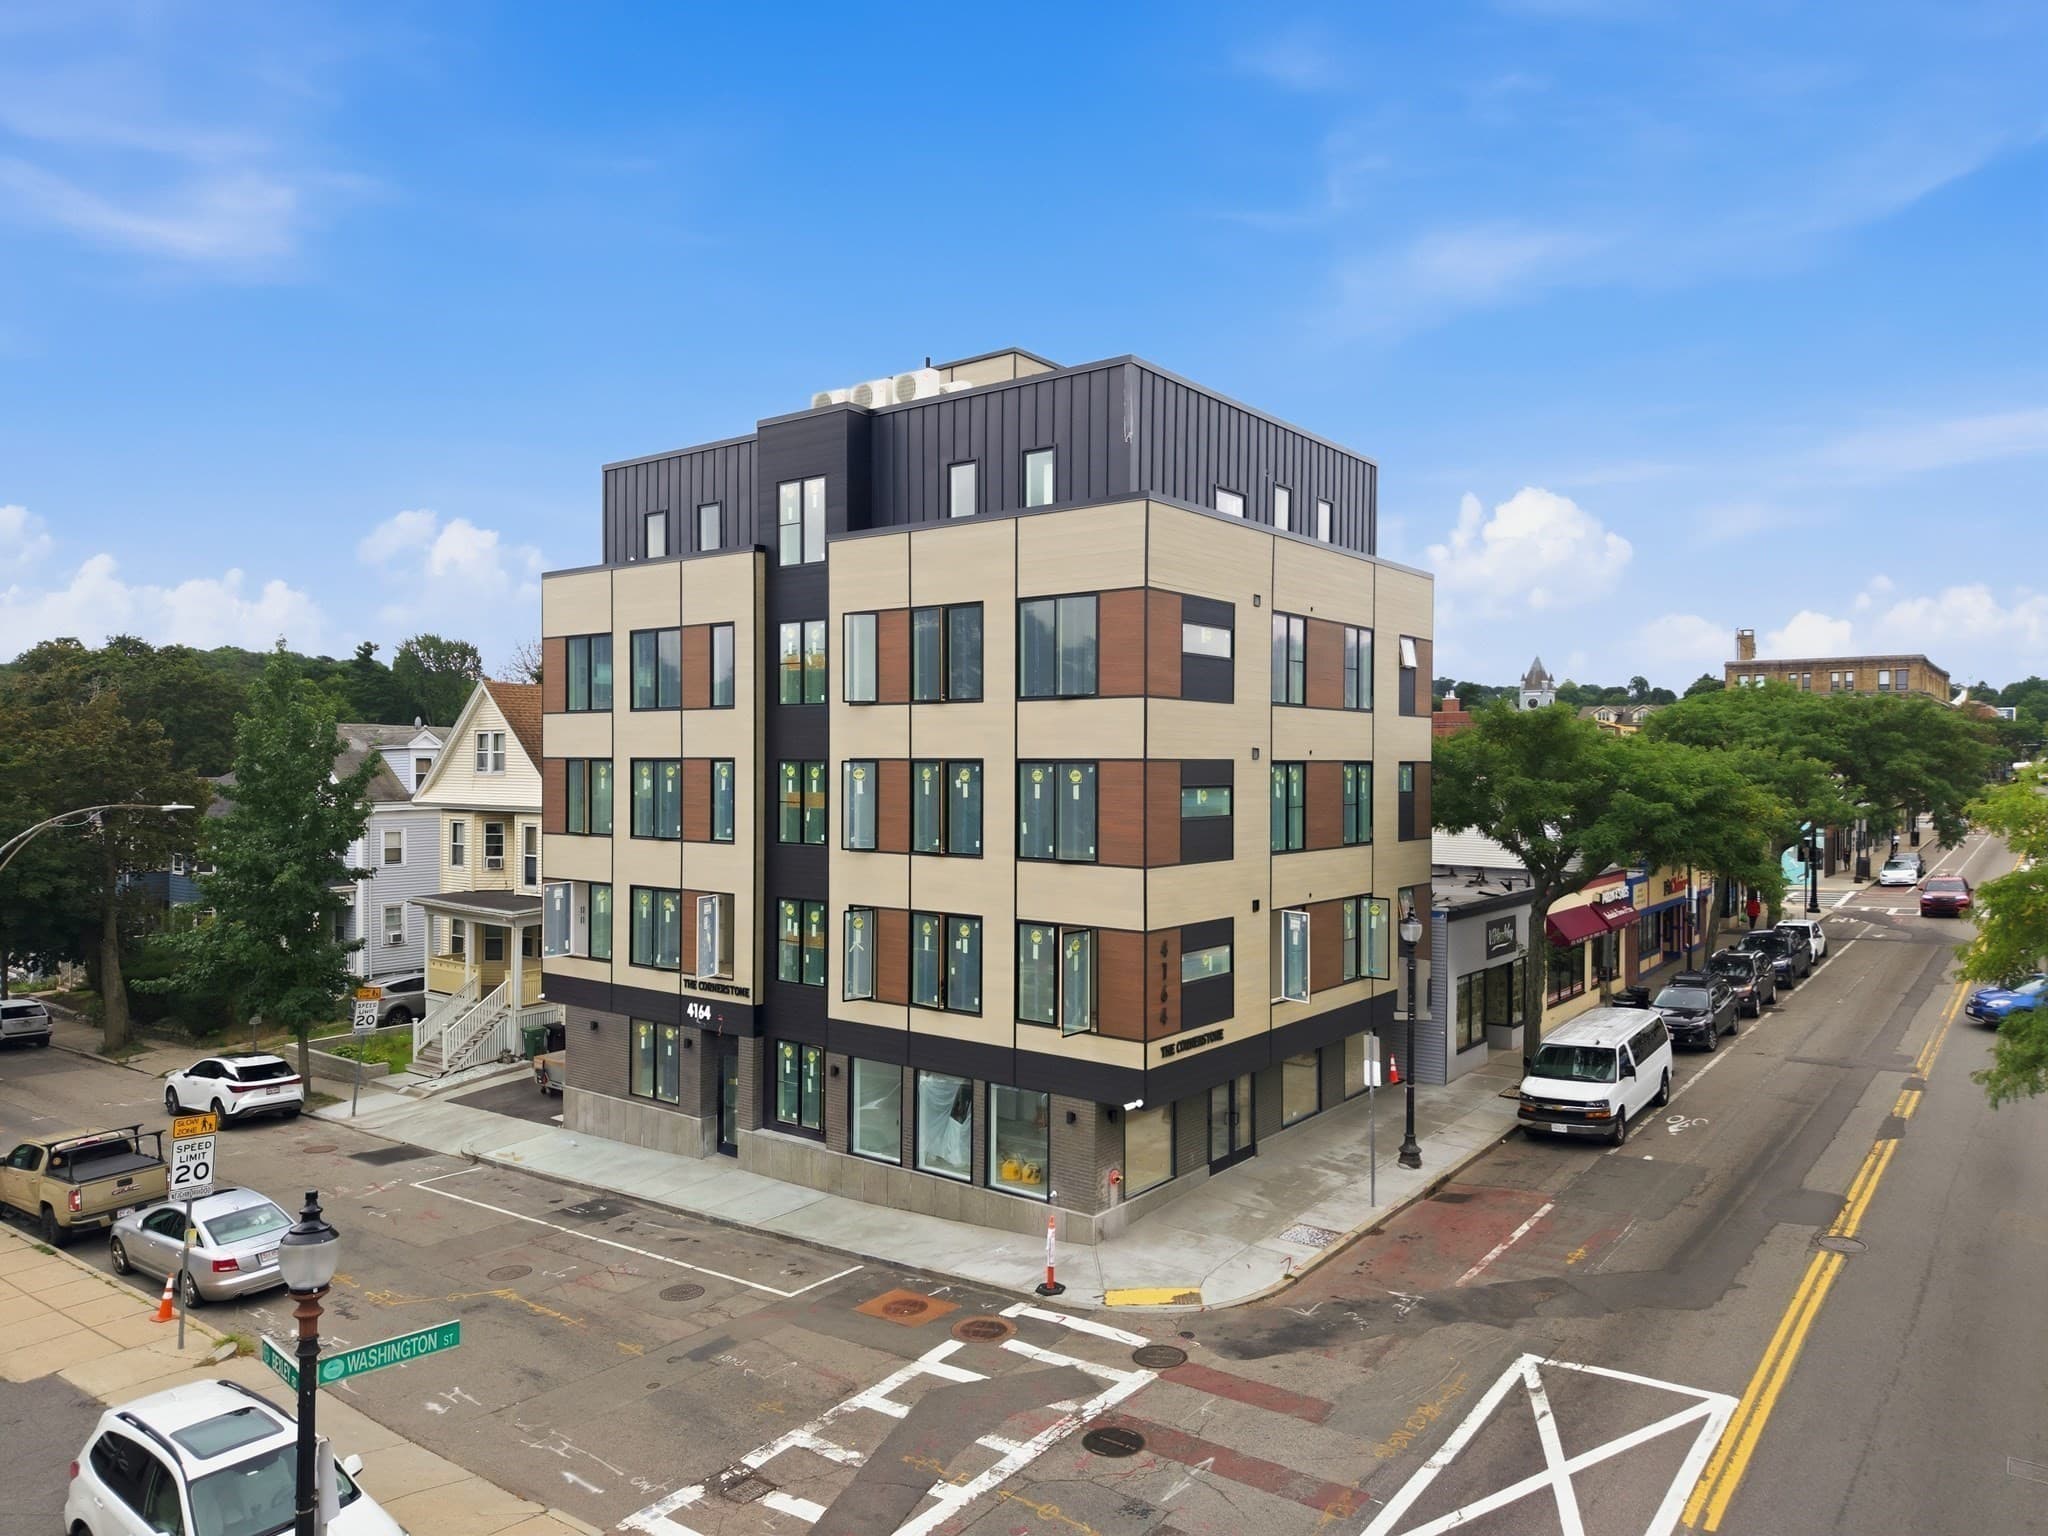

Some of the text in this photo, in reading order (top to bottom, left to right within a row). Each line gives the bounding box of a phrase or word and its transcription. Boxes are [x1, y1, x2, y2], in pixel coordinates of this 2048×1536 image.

[683, 978, 750, 998] THE CORNERSTONE
[1160, 939, 1169, 1026] 4164
[356, 1014, 375, 1026] 20
[686, 1002, 712, 1020] 4164
[1160, 1029, 1224, 1058] THE CORNERSTONE
[176, 1118, 199, 1127] SLOW
[176, 1127, 198, 1135] ZONE
[176, 1141, 212, 1153] SPEED
[179, 1152, 207, 1163] LIMIT
[175, 1162, 209, 1184] 20
[347, 1332, 454, 1372] WASHINGTON ST
[271, 1352, 292, 1383] BEXLEY
